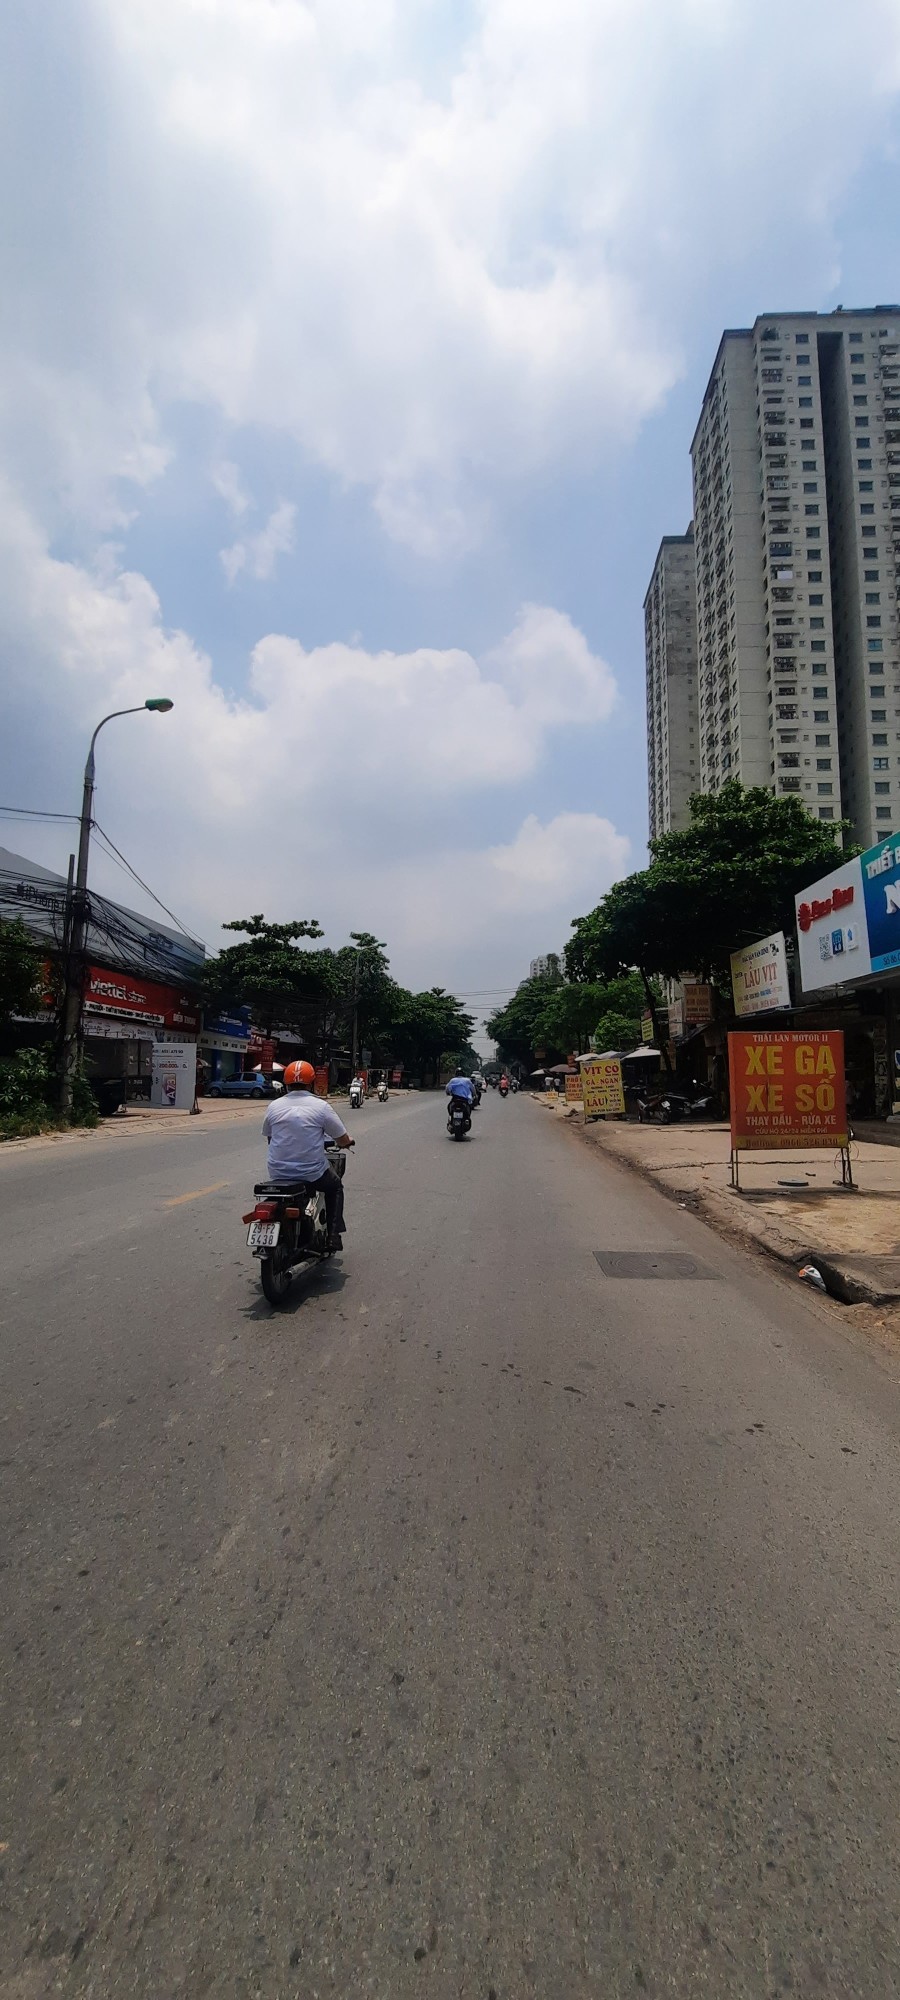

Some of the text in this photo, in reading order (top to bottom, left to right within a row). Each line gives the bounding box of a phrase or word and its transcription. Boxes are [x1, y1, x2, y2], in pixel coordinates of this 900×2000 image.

[866, 846, 894, 879] THIẾT
[762, 962, 777, 985] VỊT
[90, 978, 127, 1001] viettel
[753, 1034, 772, 1042] THÁI
[774, 1034, 790, 1042] LAN
[792, 1034, 820, 1042] MOTOR
[744, 1045, 836, 1075] XE GA
[584, 1066, 602, 1076] VỊT
[167, 1079, 176, 1098] A73
[746, 1074, 836, 1113] XE SỐ
[746, 1115, 770, 1126] THAY
[802, 1112, 821, 1125] RỬA
[824, 1115, 836, 1125] XE
[252, 1224, 276, 1234] 29-F2
[250, 1234, 274, 1245] 5438
